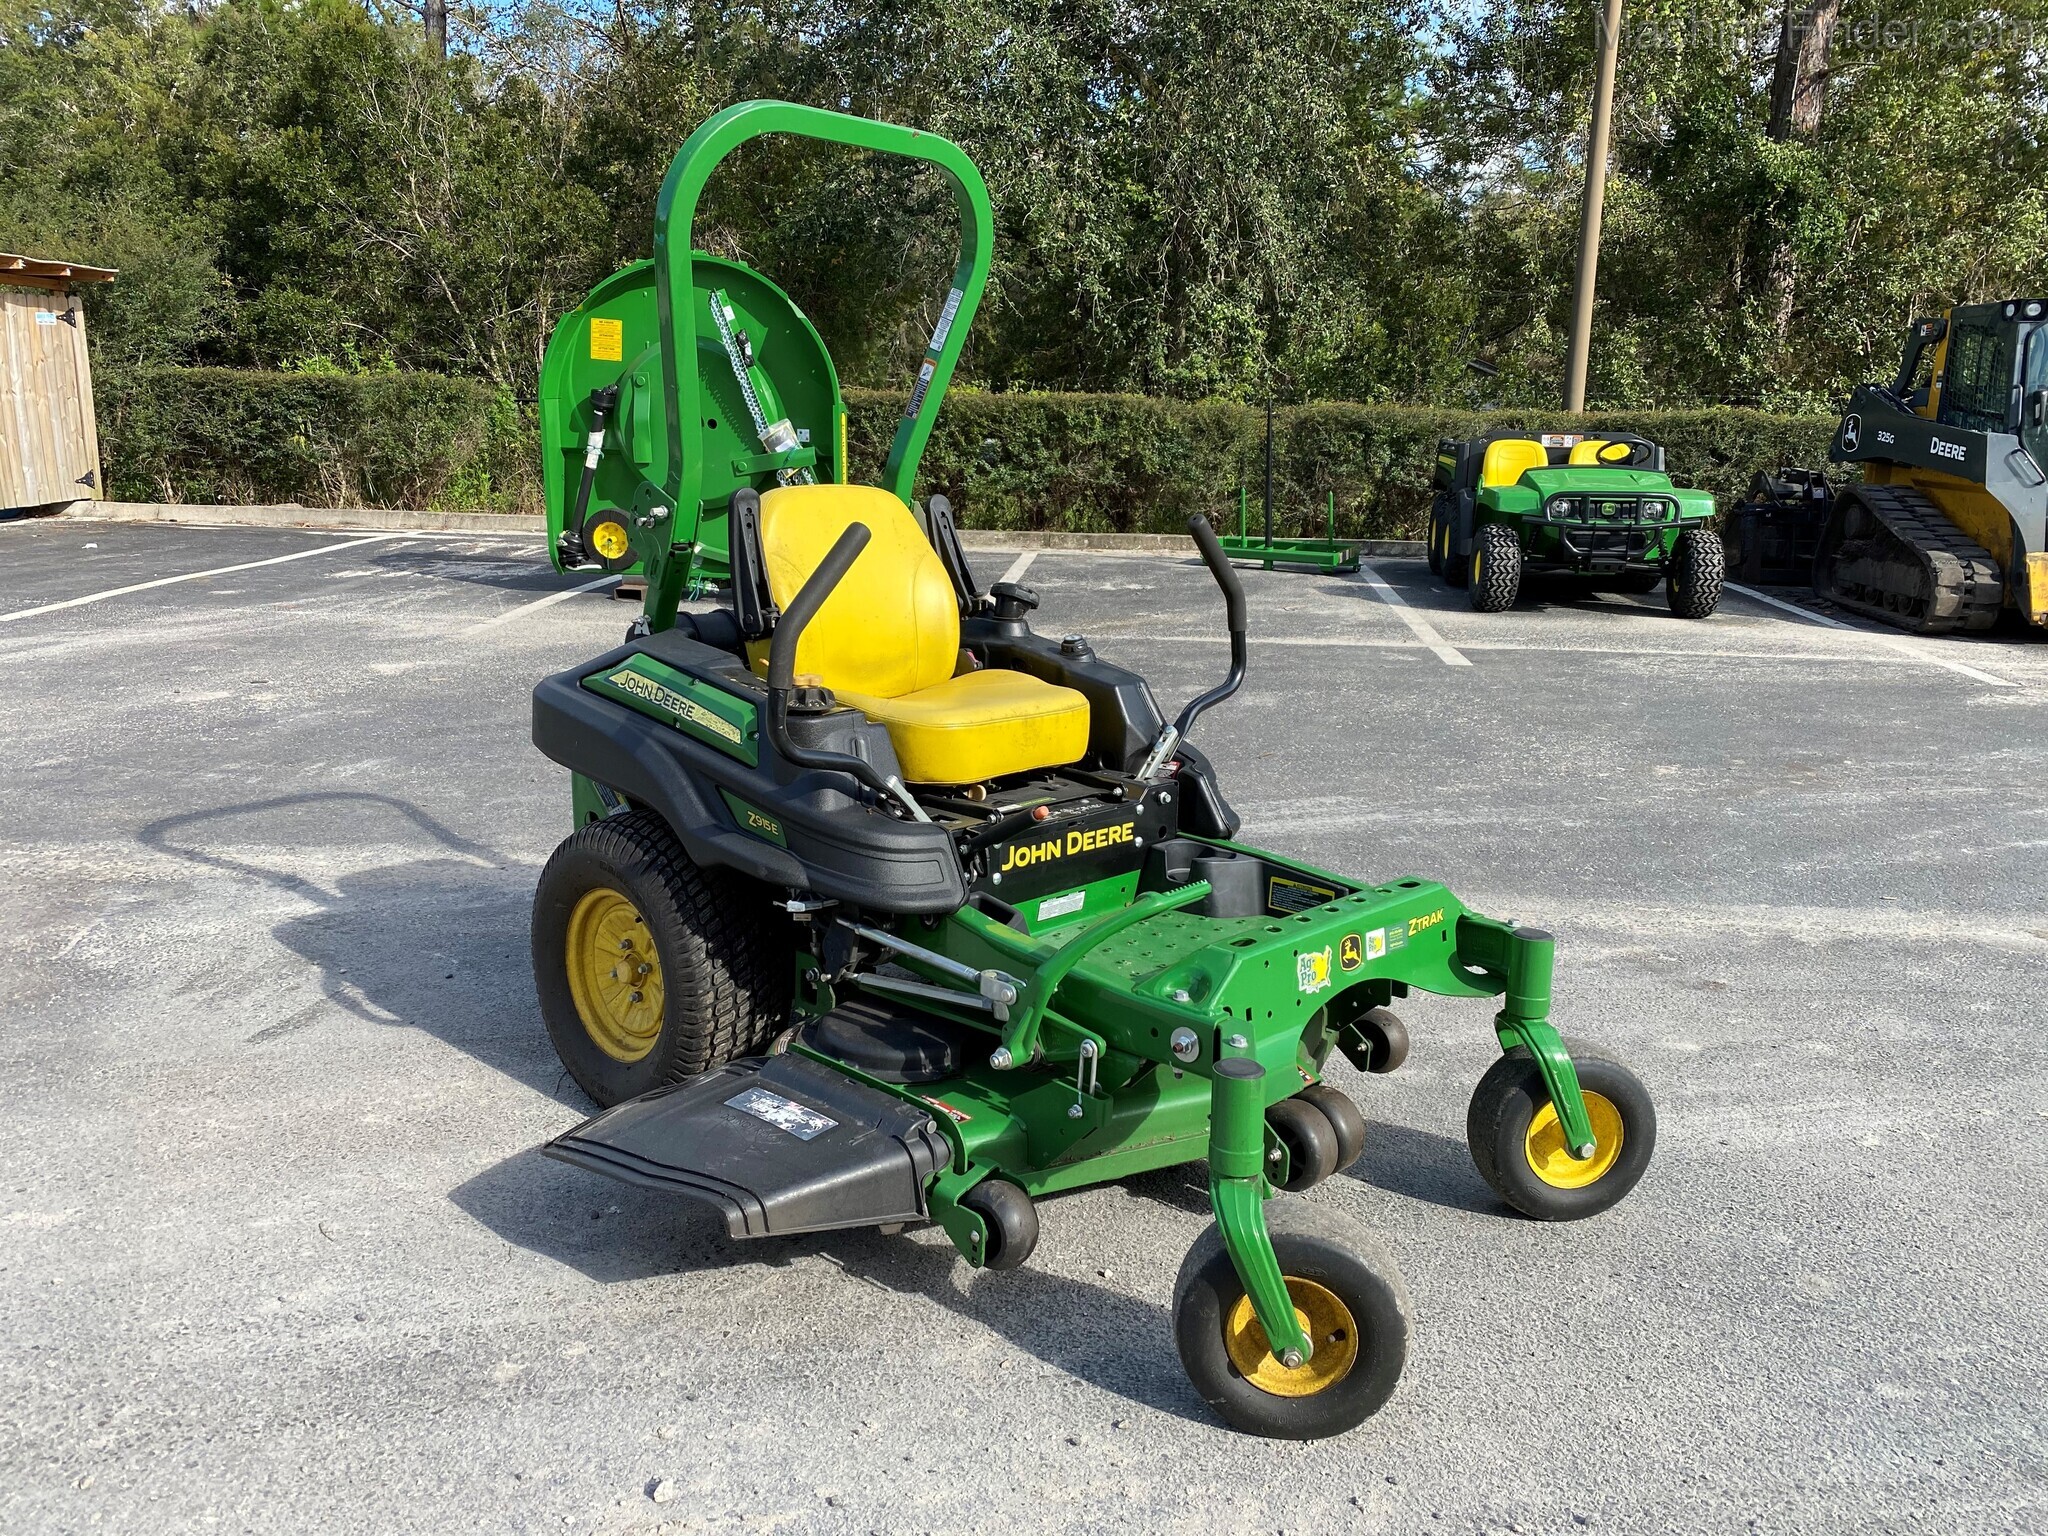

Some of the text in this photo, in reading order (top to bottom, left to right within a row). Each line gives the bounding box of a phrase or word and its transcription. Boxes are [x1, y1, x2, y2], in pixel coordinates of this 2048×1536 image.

[1876, 430, 1895, 445] 325G
[1929, 436, 1967, 462] DEERE
[619, 672, 696, 719] JOHN DEERE
[746, 810, 780, 837] Z915E
[1001, 821, 1135, 872] JOHN DEERE
[1407, 908, 1445, 938] ZTRAK
[1300, 970, 1317, 987] Pro
